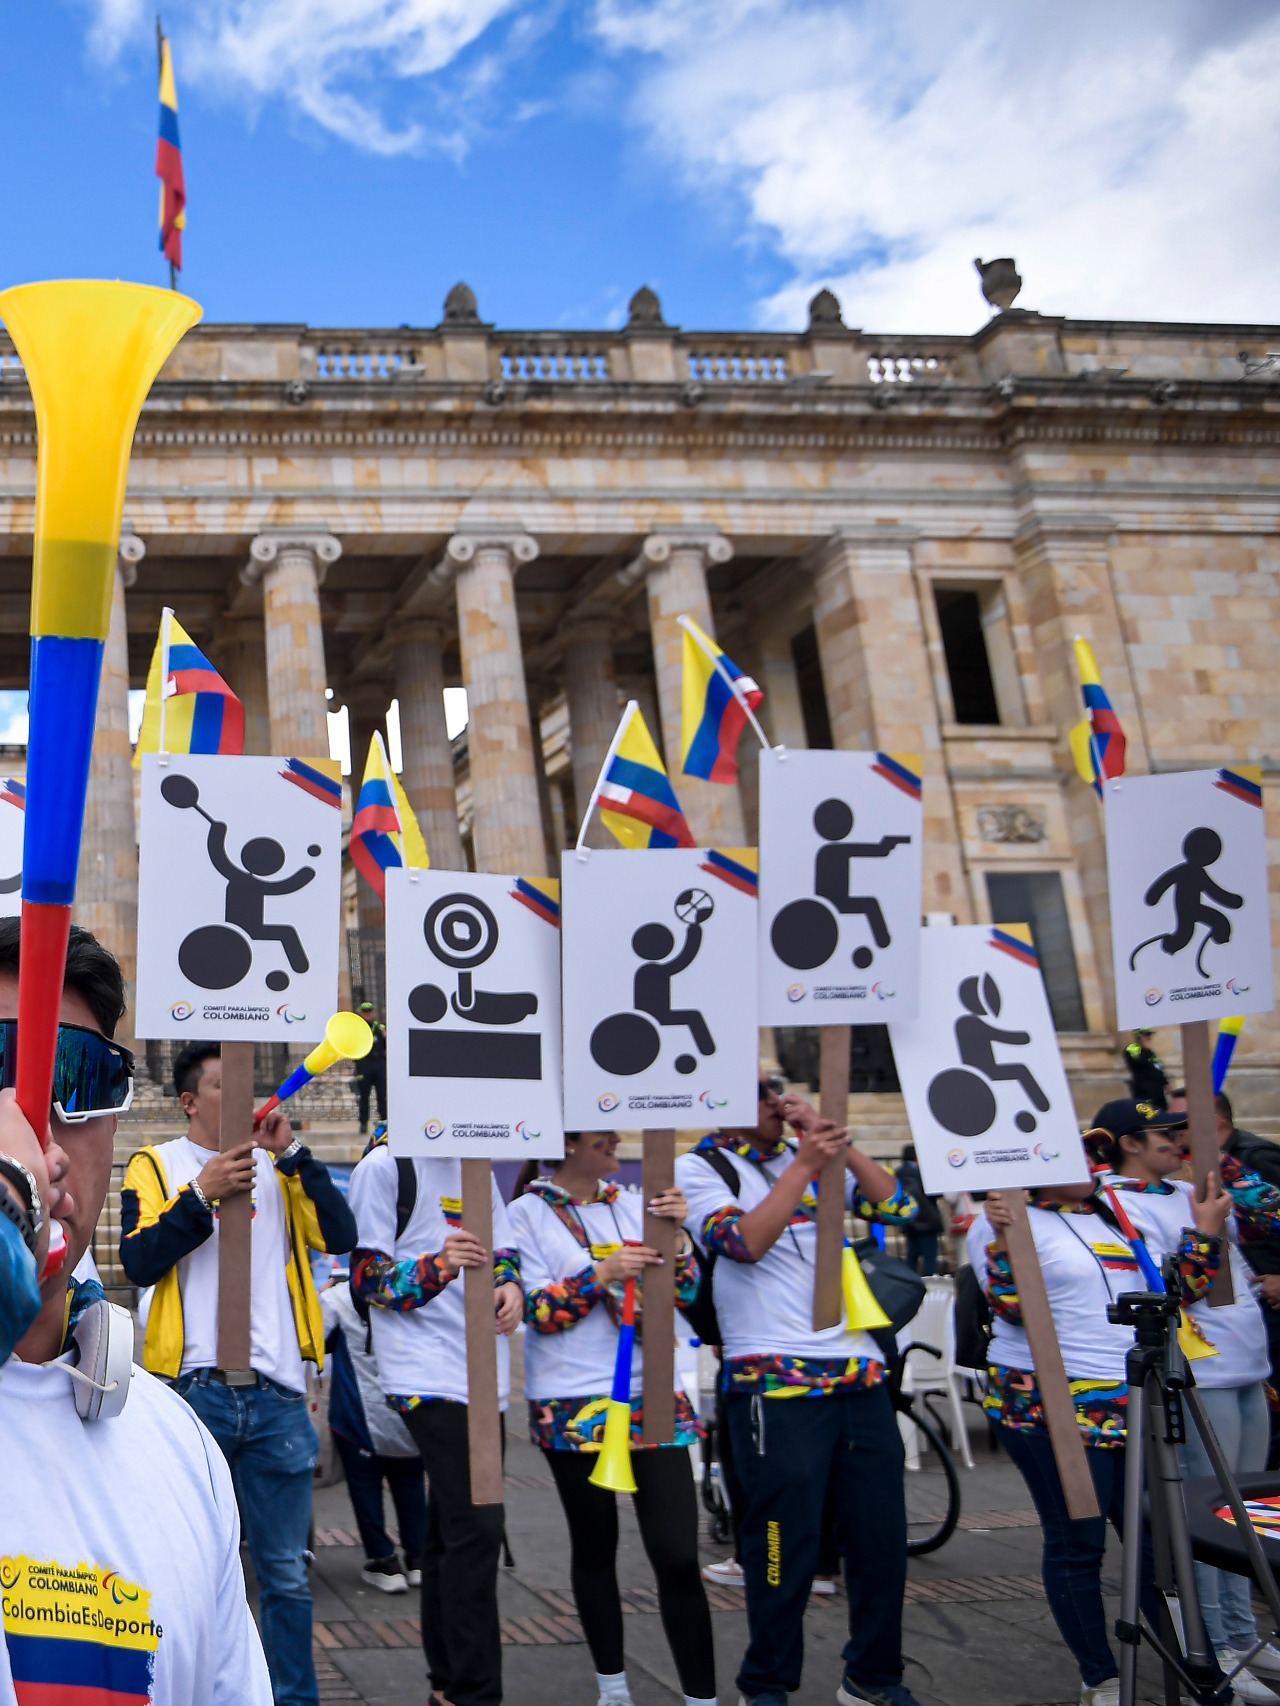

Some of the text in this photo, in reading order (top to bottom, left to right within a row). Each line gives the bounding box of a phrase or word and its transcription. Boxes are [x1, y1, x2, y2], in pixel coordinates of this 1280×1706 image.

[1169, 989, 1221, 1001] COLOMBIANO
[203, 1011, 270, 1021] COLOMBIANO
[628, 1100, 692, 1109] COLOMBIANO
[452, 1130, 510, 1138] COLOMBIANO
[767, 1520, 780, 1587] COLOMBIA
[28, 1565, 98, 1582] COMITÉ PARALÍMPICO
[28, 1577, 98, 1596] COLOMBIANO
